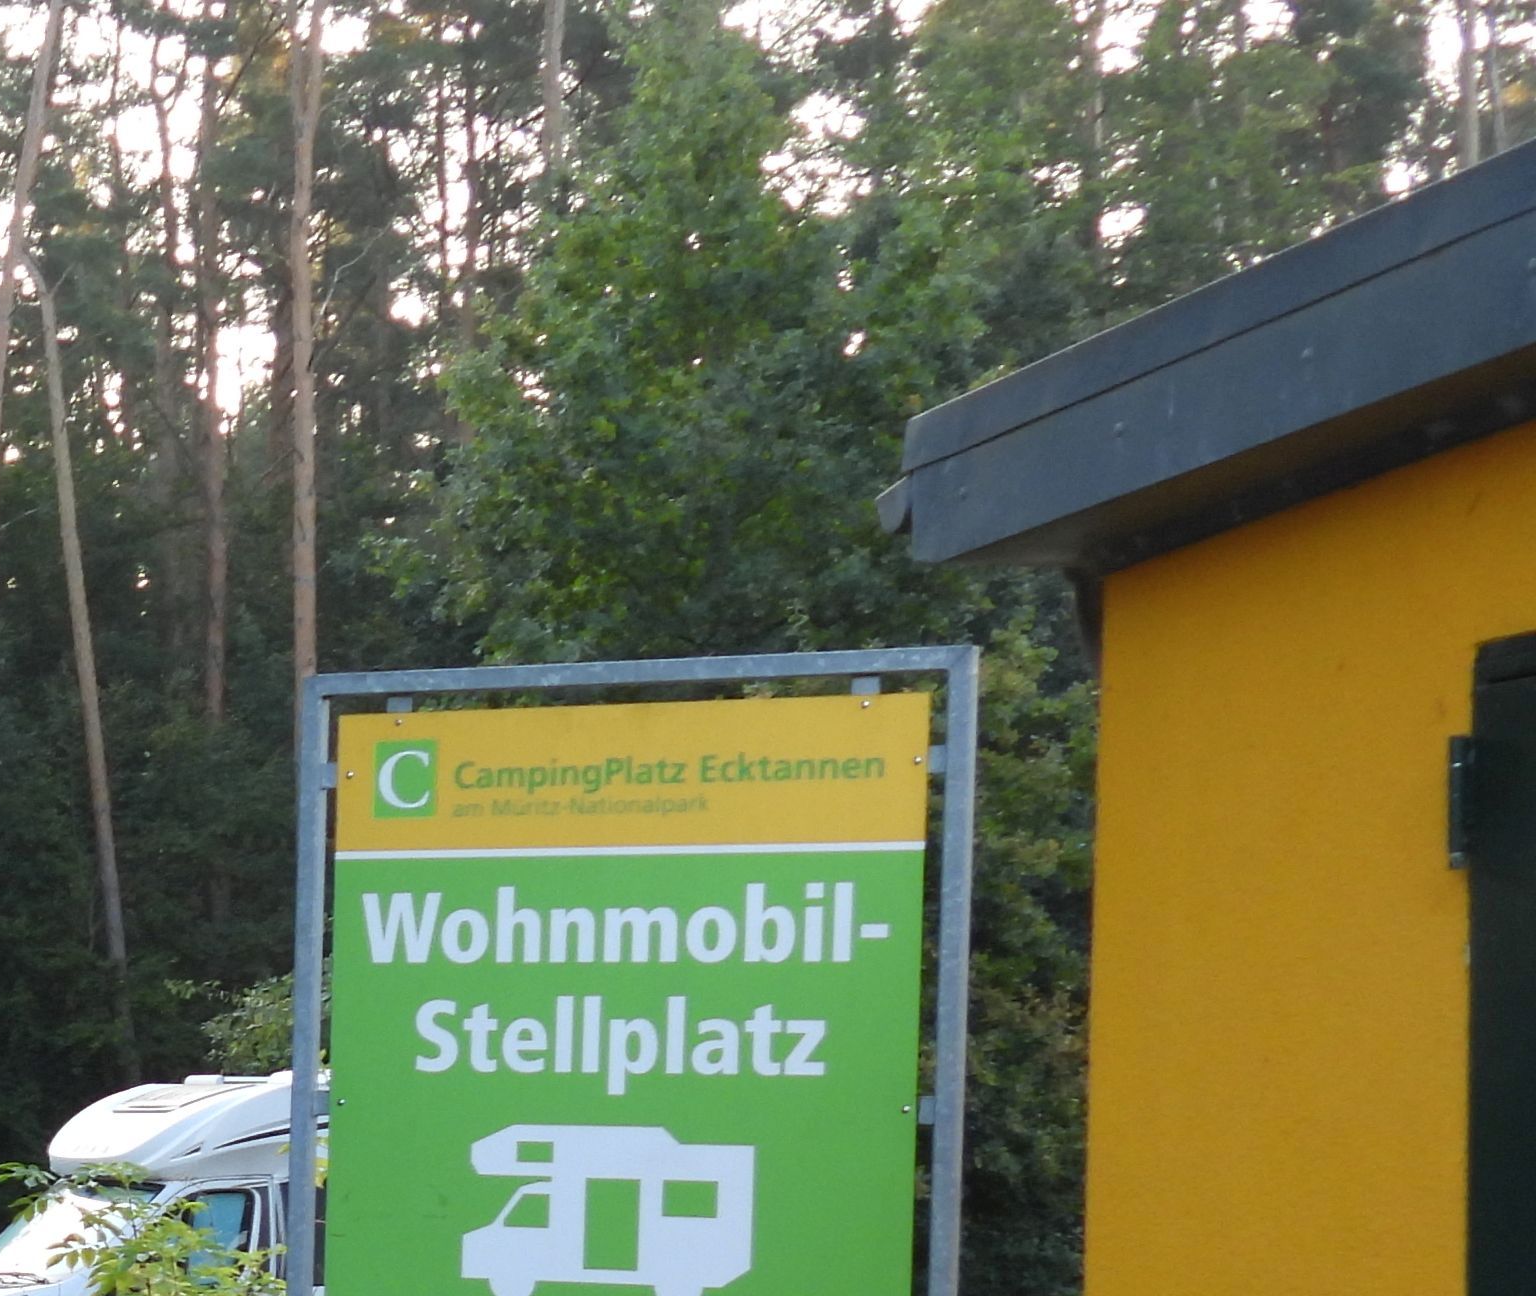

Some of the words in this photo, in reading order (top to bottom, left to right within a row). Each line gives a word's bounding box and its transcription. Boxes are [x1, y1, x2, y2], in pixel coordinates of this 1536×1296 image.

[376, 749, 432, 810] C
[453, 756, 688, 794] CampingPlatz
[700, 753, 885, 783] Ecktannen
[452, 801, 484, 818] am
[361, 881, 890, 965] Wohnmobil-
[415, 995, 827, 1097] Stellplatz
